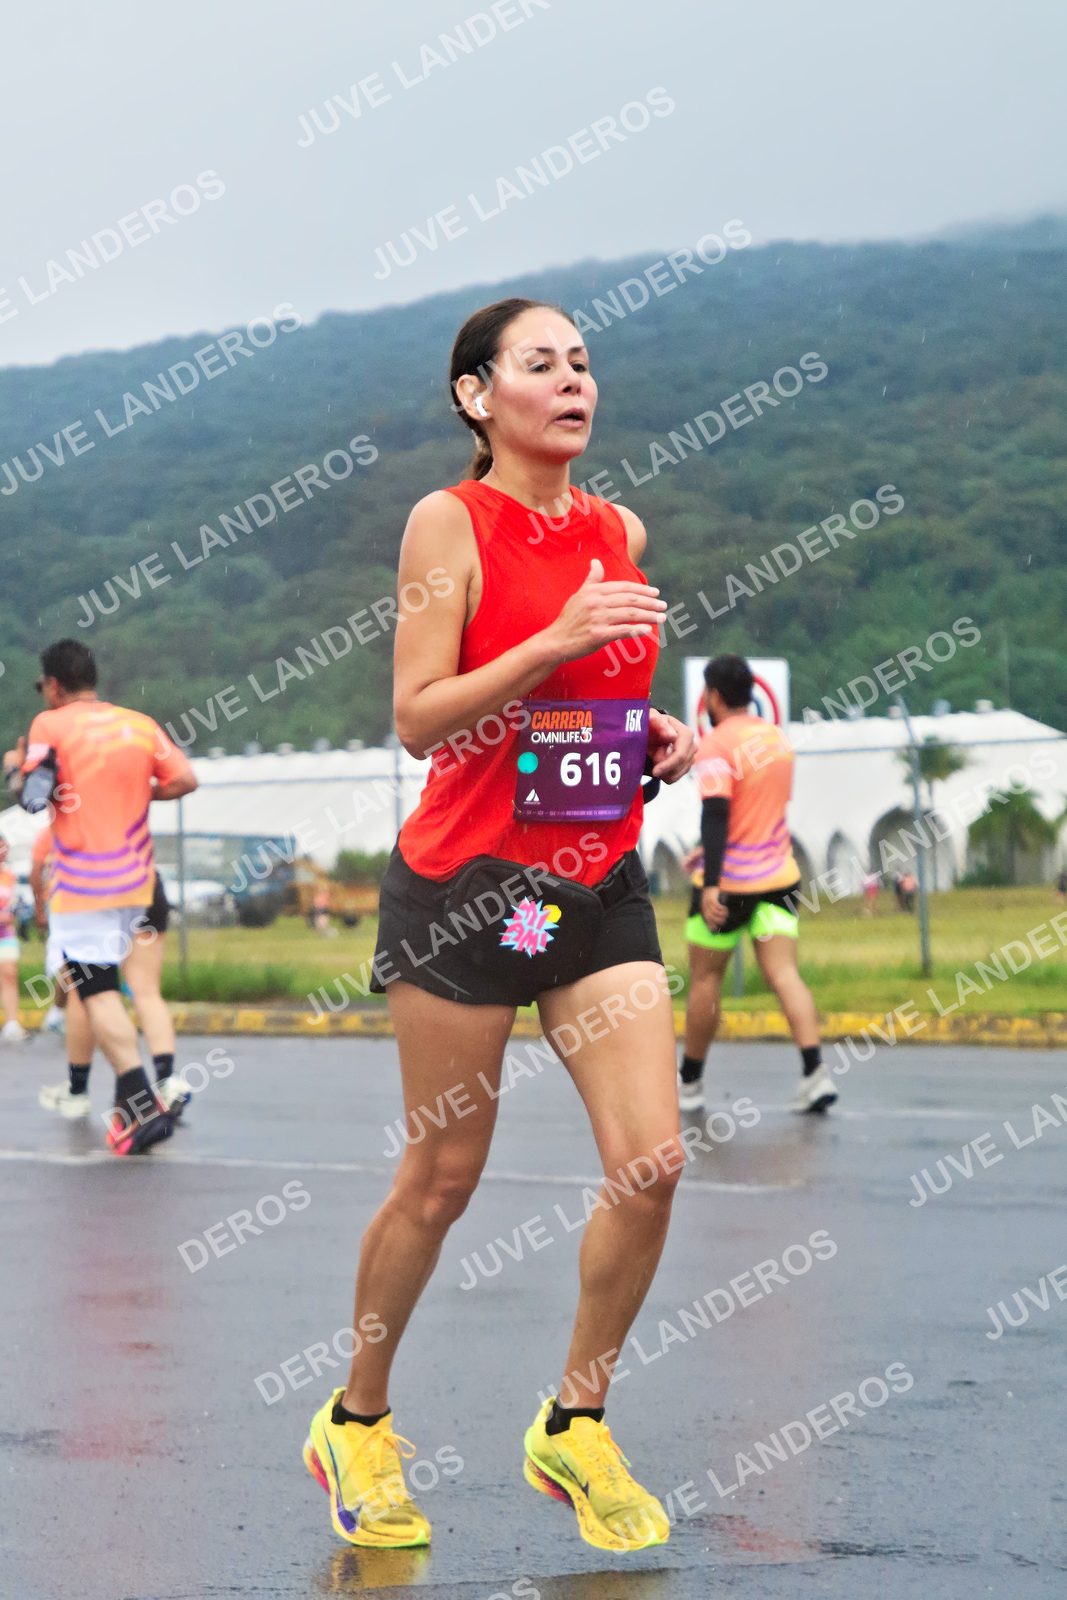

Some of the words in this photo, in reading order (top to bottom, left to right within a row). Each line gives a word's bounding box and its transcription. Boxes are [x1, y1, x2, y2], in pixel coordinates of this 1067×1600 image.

[531, 710, 593, 730] CARRERA
[625, 709, 643, 732] 15K
[560, 751, 621, 786] 616
